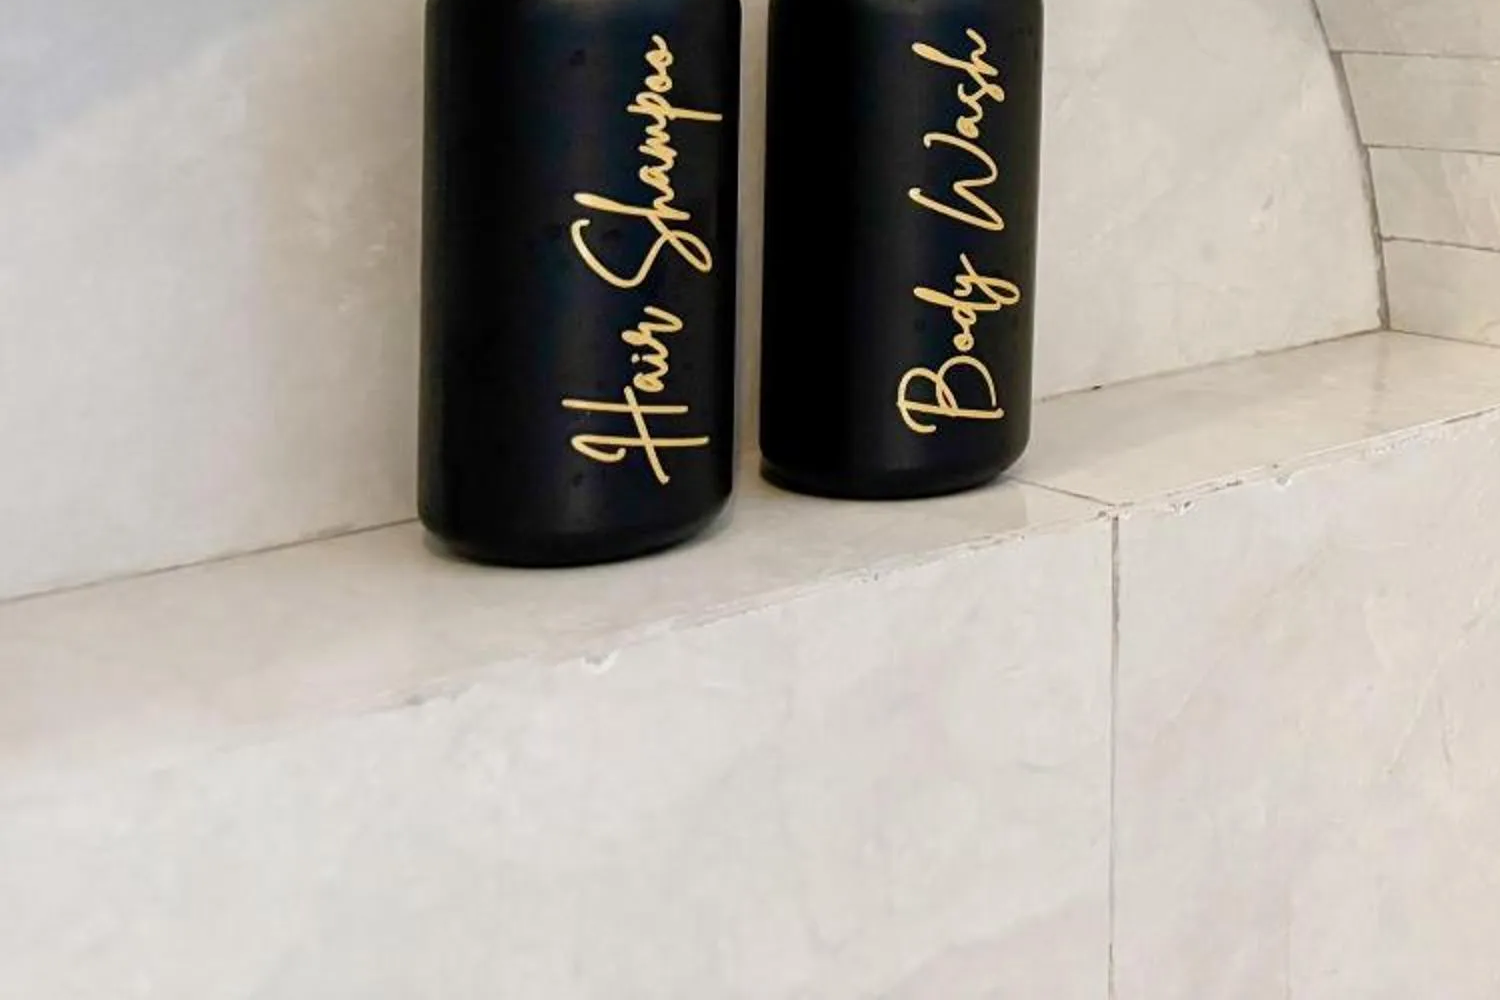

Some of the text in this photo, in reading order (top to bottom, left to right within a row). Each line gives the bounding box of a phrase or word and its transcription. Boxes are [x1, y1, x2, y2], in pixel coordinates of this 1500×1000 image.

[563, 34, 723, 485] Hair Shampoo
[897, 29, 1021, 434] Body Wash
